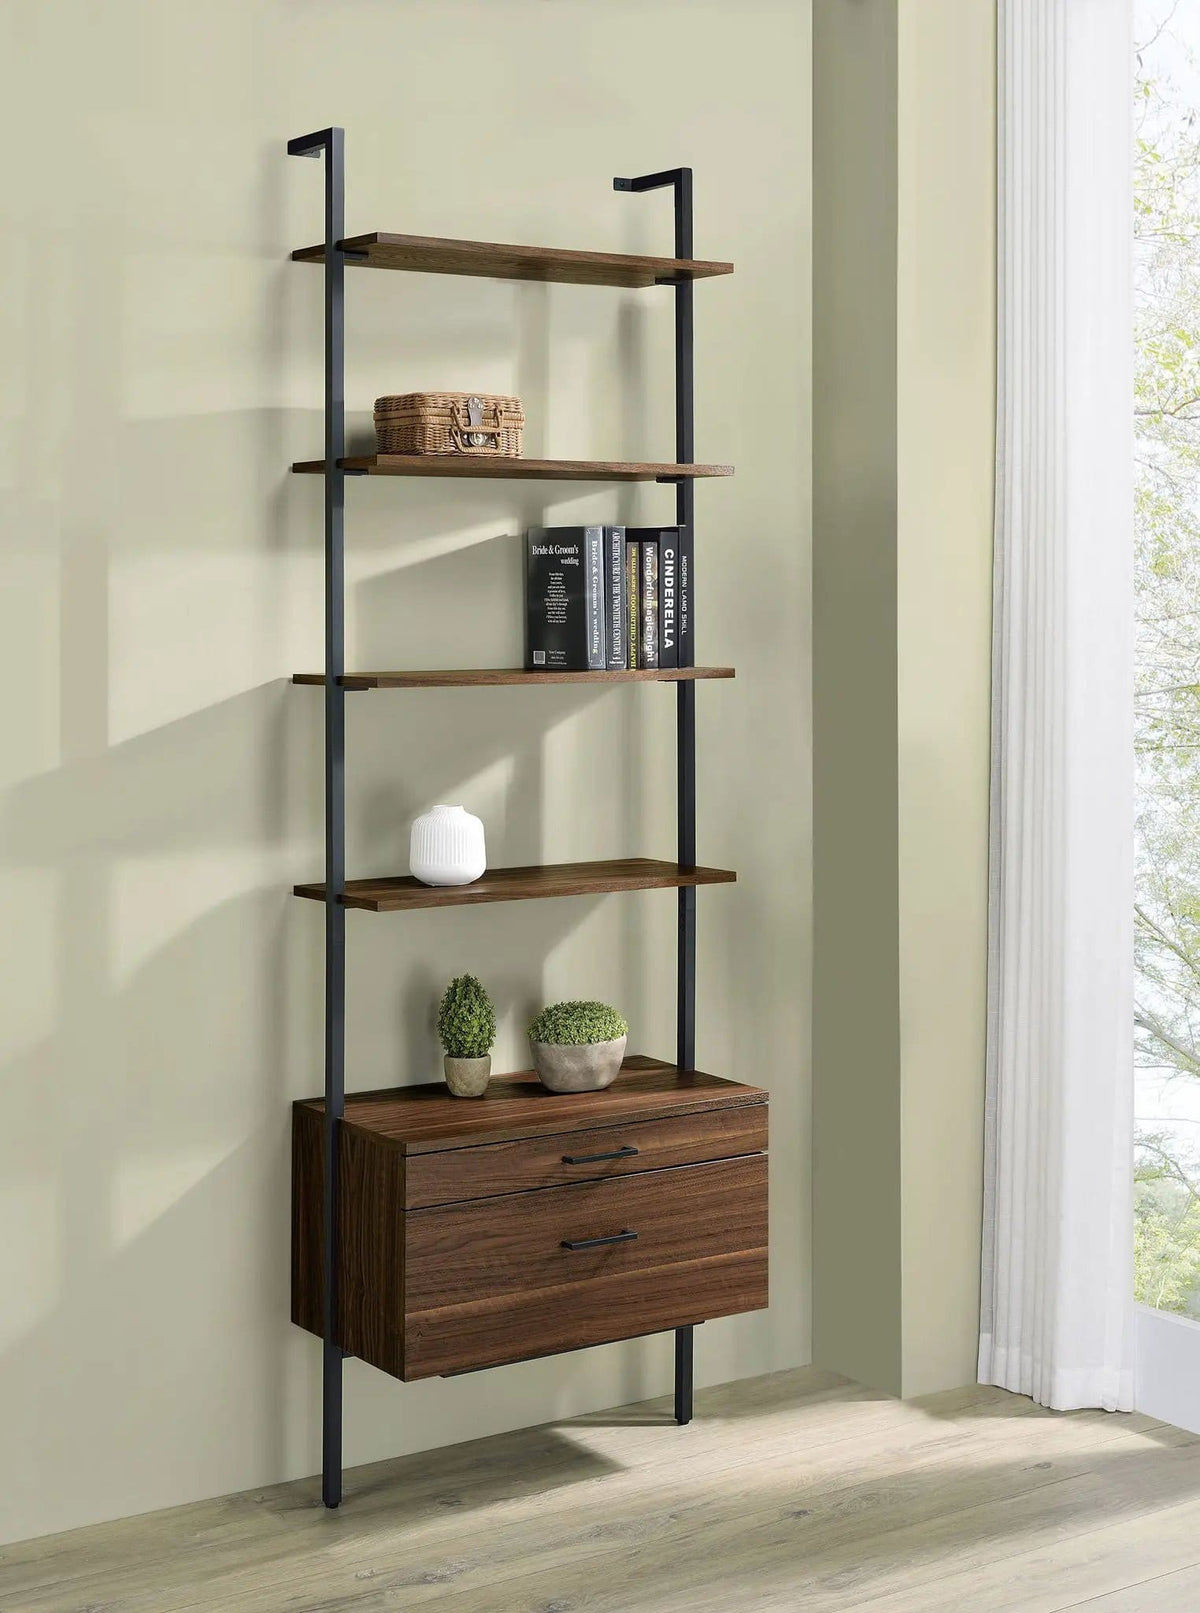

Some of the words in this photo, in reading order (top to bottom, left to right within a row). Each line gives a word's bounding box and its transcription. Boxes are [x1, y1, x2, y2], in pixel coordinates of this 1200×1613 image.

[532, 545, 548, 555] Bride
[549, 544, 554, 555] &
[554, 544, 579, 555] Groom's
[592, 566, 599, 575] &
[612, 582, 621, 595] THE
[664, 548, 675, 649] CINDERELLA
[612, 595, 621, 629] TWENTIETH
[592, 618, 600, 654] wedding
[612, 628, 621, 656] CENTURY
[646, 634, 655, 662] night
